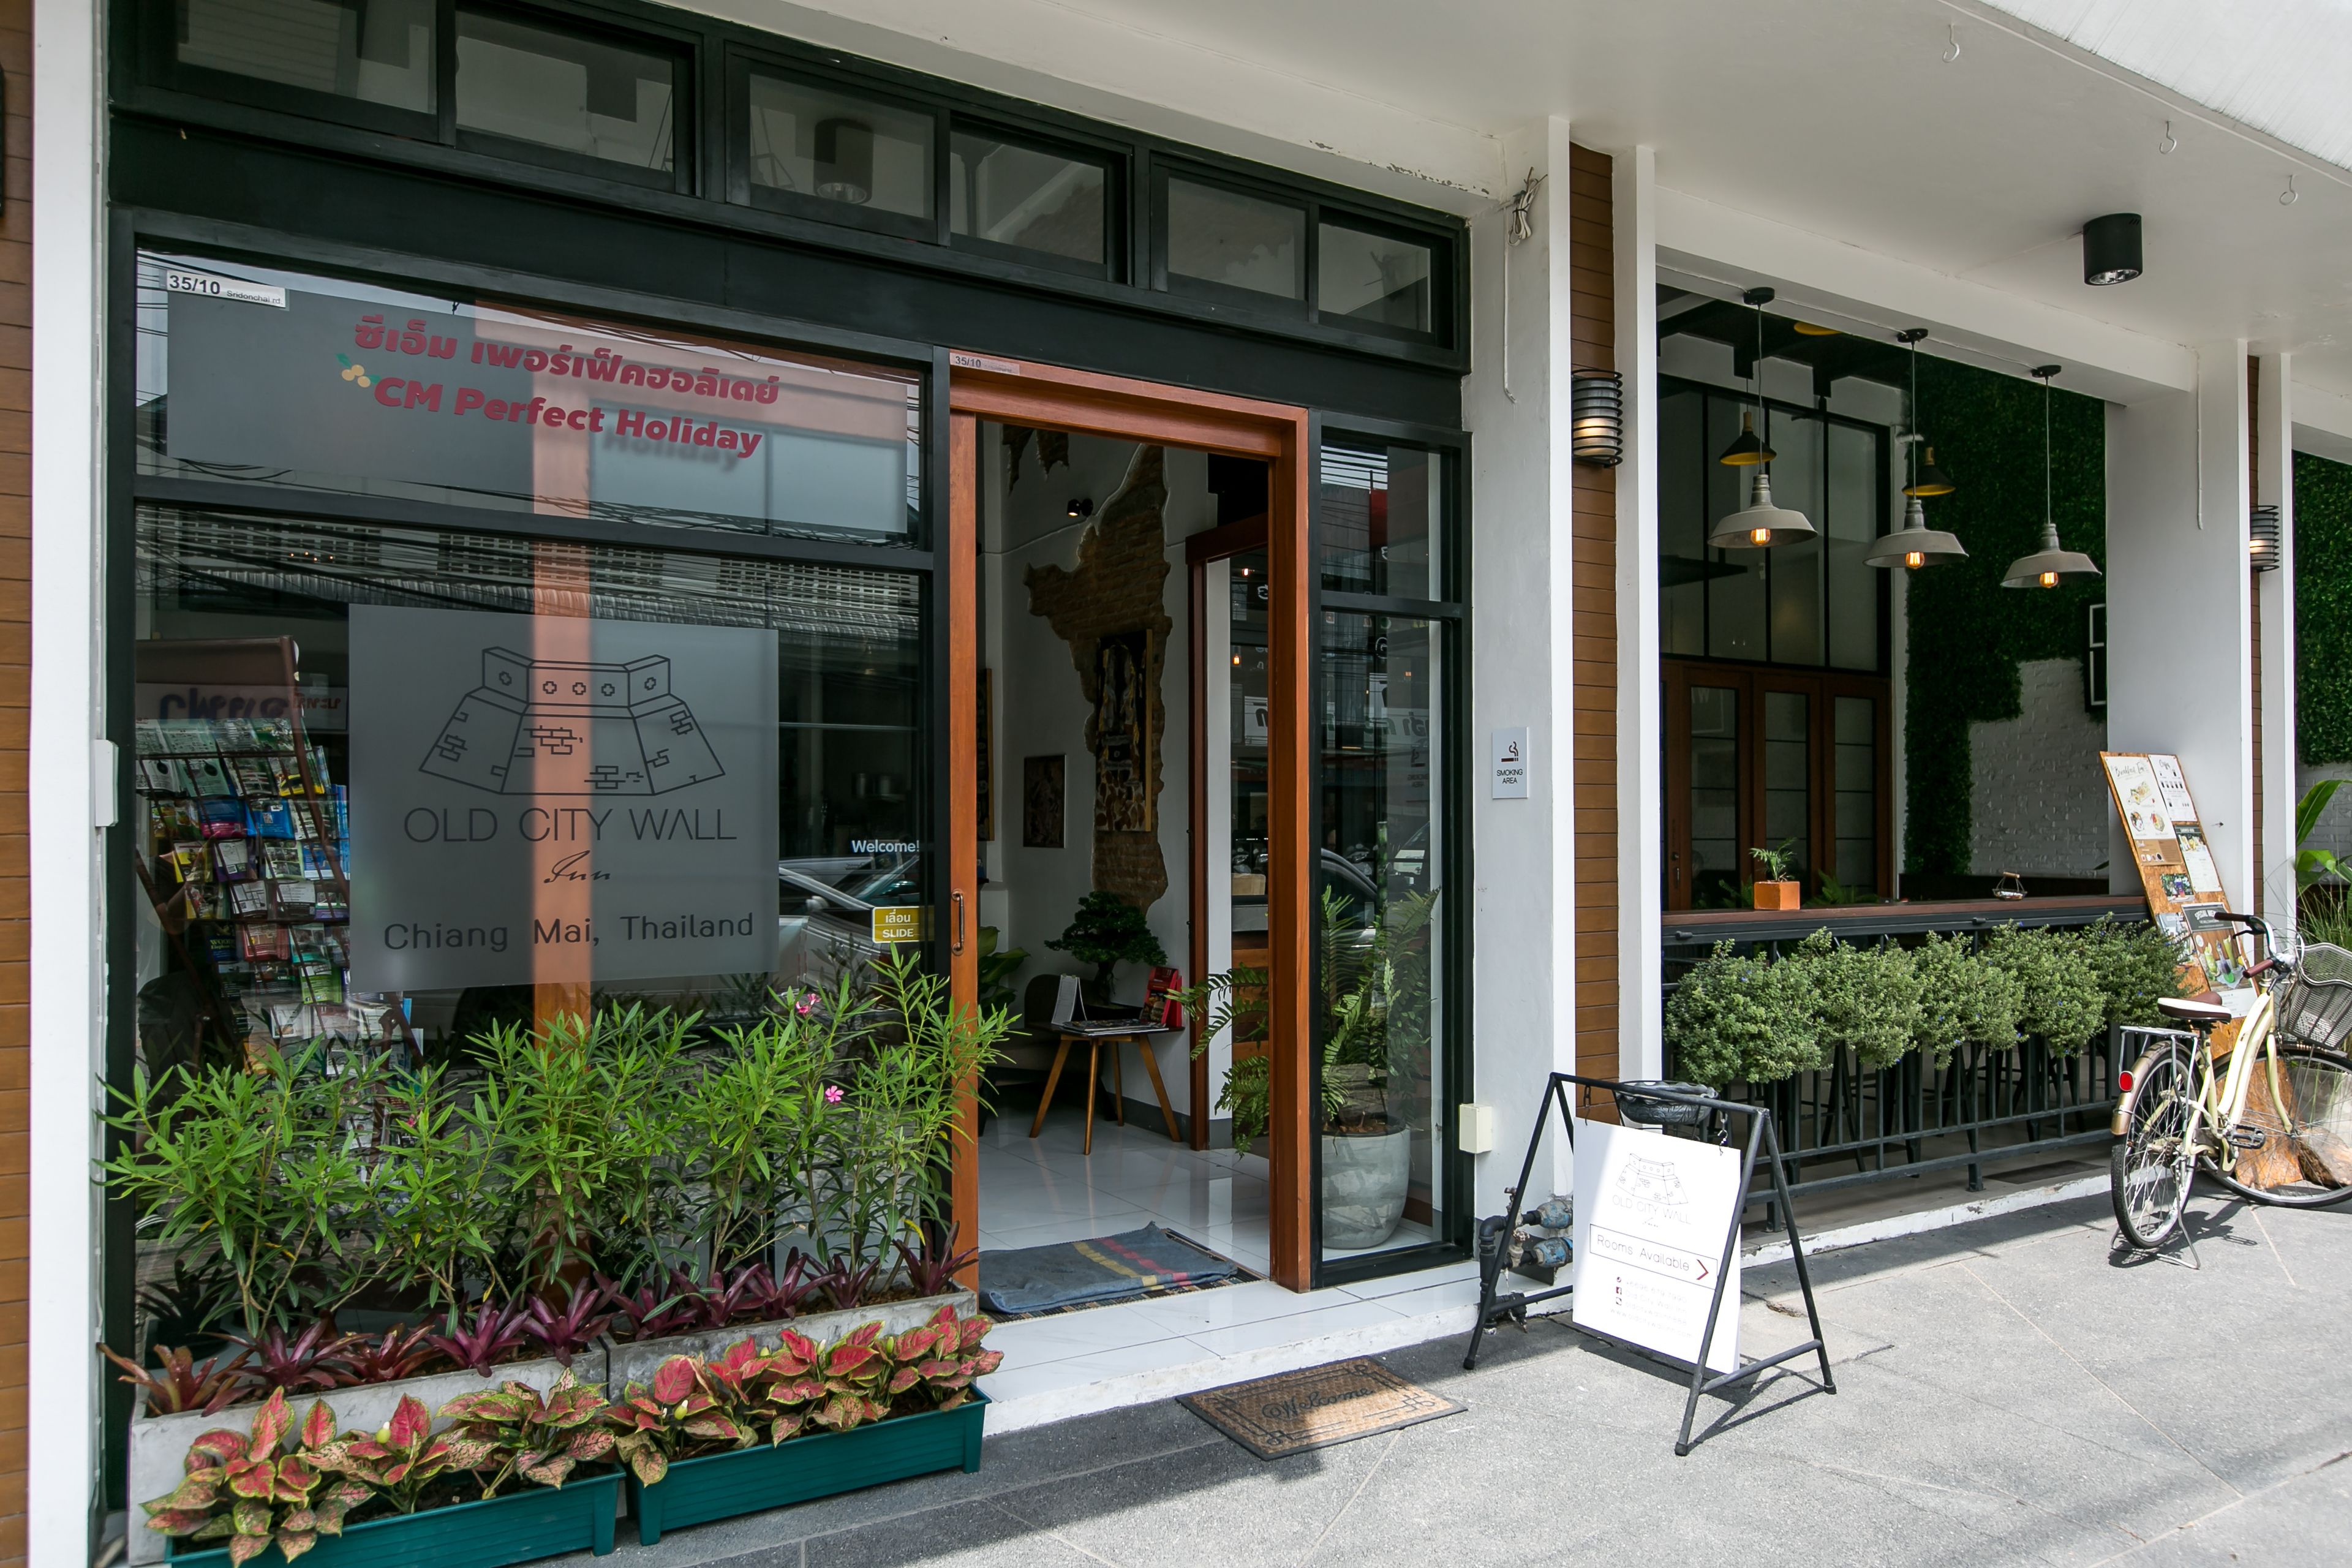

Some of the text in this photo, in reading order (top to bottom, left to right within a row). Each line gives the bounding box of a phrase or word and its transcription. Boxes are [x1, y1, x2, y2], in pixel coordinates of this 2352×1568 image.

[169, 275, 221, 295] 35/10
[227, 290, 270, 303] Sridonchai
[355, 314, 458, 360] ซีเอ็ม
[956, 356, 981, 368] 35/10
[374, 377, 763, 458] CM Perfect Holiday
[404, 807, 737, 843] OLD CITY WALL
[851, 840, 919, 853] Welcome!
[544, 850, 611, 883] Inn
[384, 913, 753, 952] Chiang Mai, Thailand
[886, 909, 911, 923] เลื่อน
[883, 929, 914, 938] SLIDE
[1612, 1194, 1632, 1208] OLD
[1637, 1201, 1659, 1215] CITY
[1662, 1208, 1692, 1224] WALL
[1597, 1234, 1689, 1271] Rooms Available
[1261, 1387, 1374, 1422] Welcome
